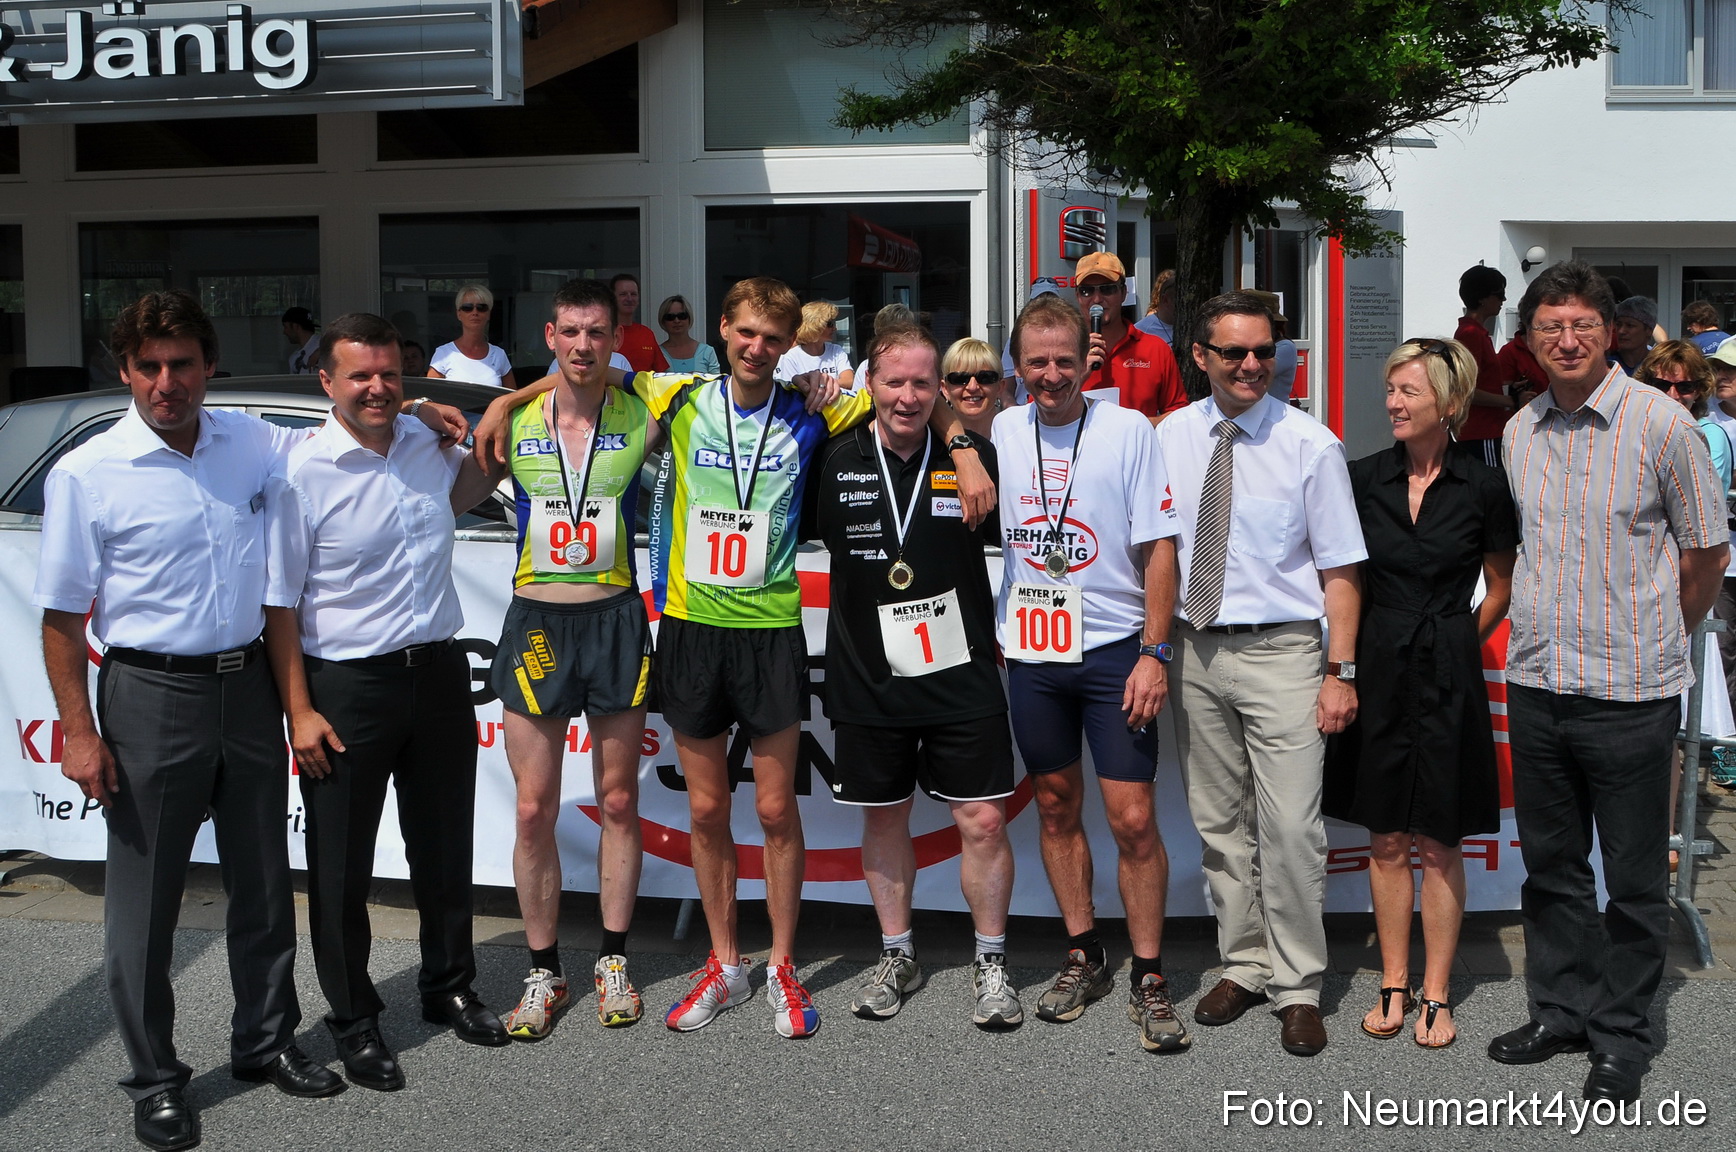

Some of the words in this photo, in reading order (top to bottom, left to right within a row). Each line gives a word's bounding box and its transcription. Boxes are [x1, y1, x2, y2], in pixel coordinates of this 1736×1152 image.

[51, 2, 314, 90] Jänig
[837, 472, 878, 483] Cellagon
[849, 490, 879, 501] killtec
[649, 451, 672, 581] www.bockonline.de
[700, 509, 736, 522] MEYER
[700, 519, 736, 530] WERBUNG
[846, 522, 882, 533] AMADEUS
[550, 521, 597, 566] 99
[1006, 528, 1077, 546] GERHART
[1078, 536, 1086, 544] &
[1008, 542, 1033, 550] UTOHAUS
[707, 531, 747, 578] 10
[1018, 587, 1050, 598] MEYER
[1018, 596, 1051, 606] WERBUNG
[893, 603, 930, 616] MEYER
[893, 611, 932, 622] WERBUNG
[1016, 607, 1072, 654] 100
[913, 622, 934, 664] 1
[530, 634, 555, 668] Run!
[32, 790, 73, 820] The
